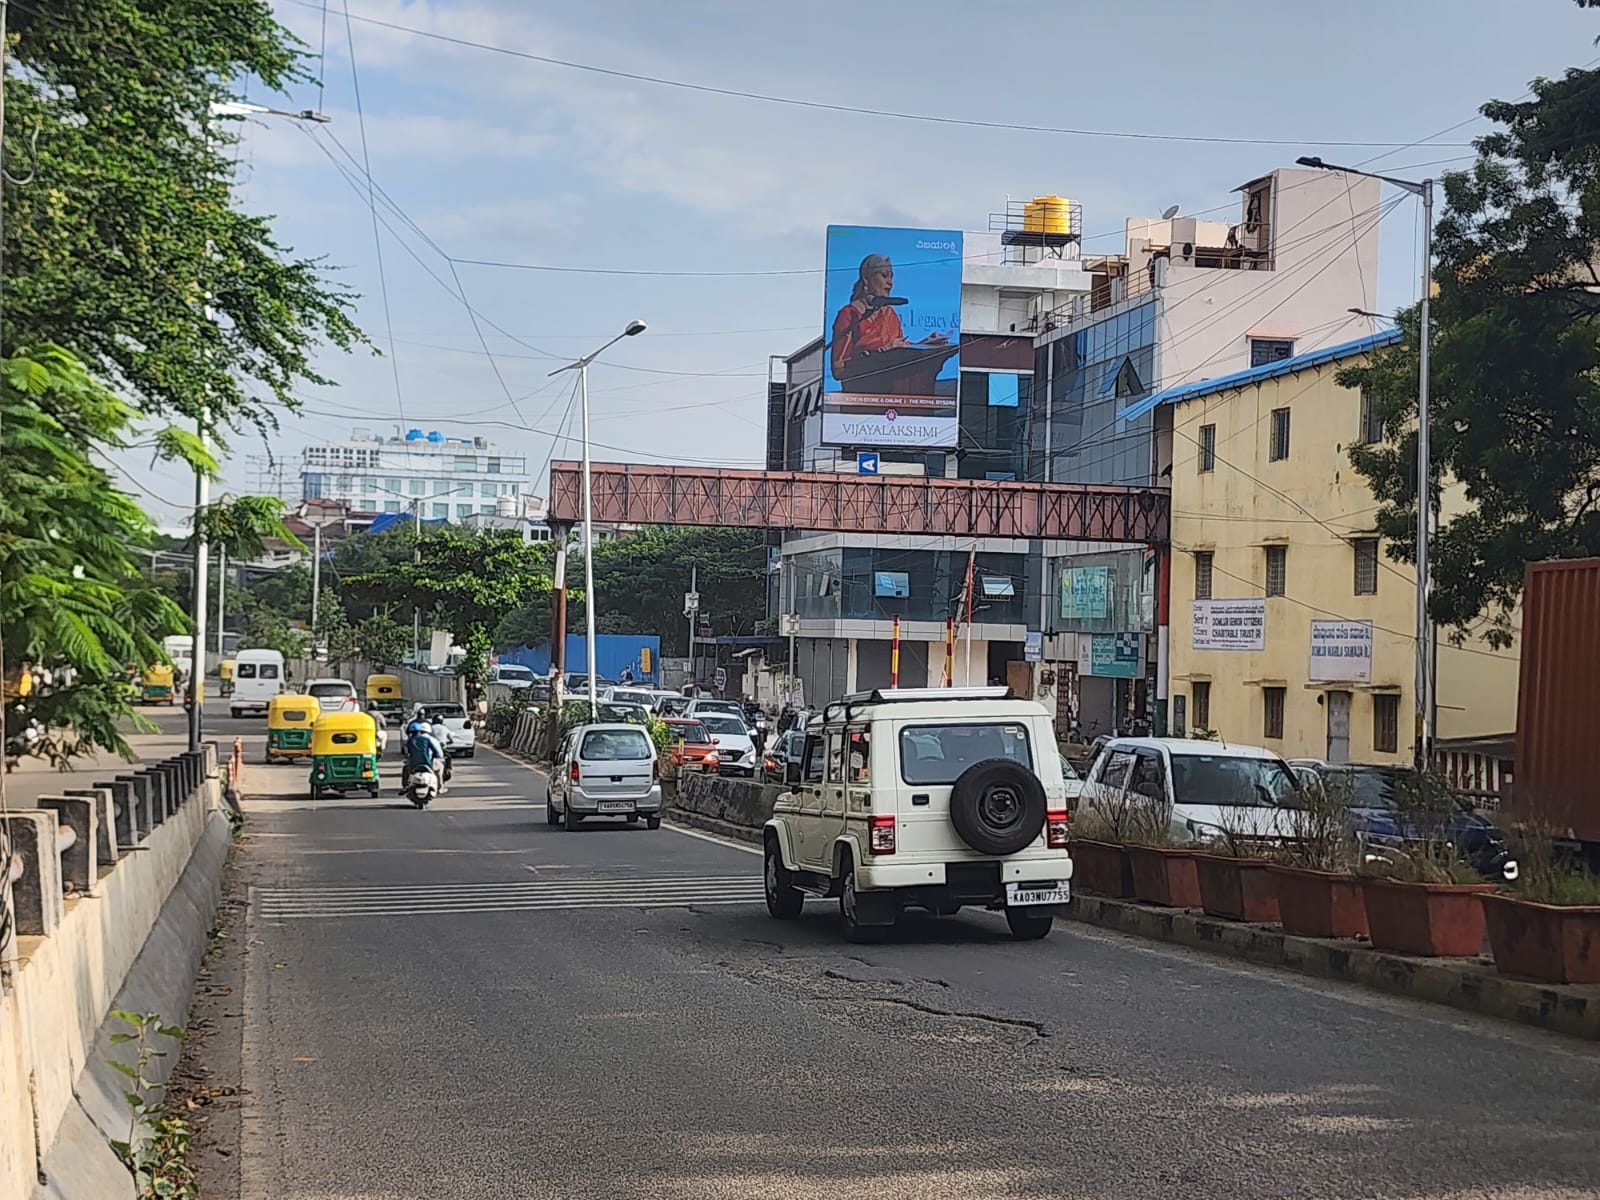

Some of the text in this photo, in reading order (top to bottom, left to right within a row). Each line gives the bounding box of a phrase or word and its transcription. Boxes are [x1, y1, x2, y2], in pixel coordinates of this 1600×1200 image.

[910, 309, 959, 330] Legacy &
[842, 423, 938, 438] VIJAYALAKSHMI
